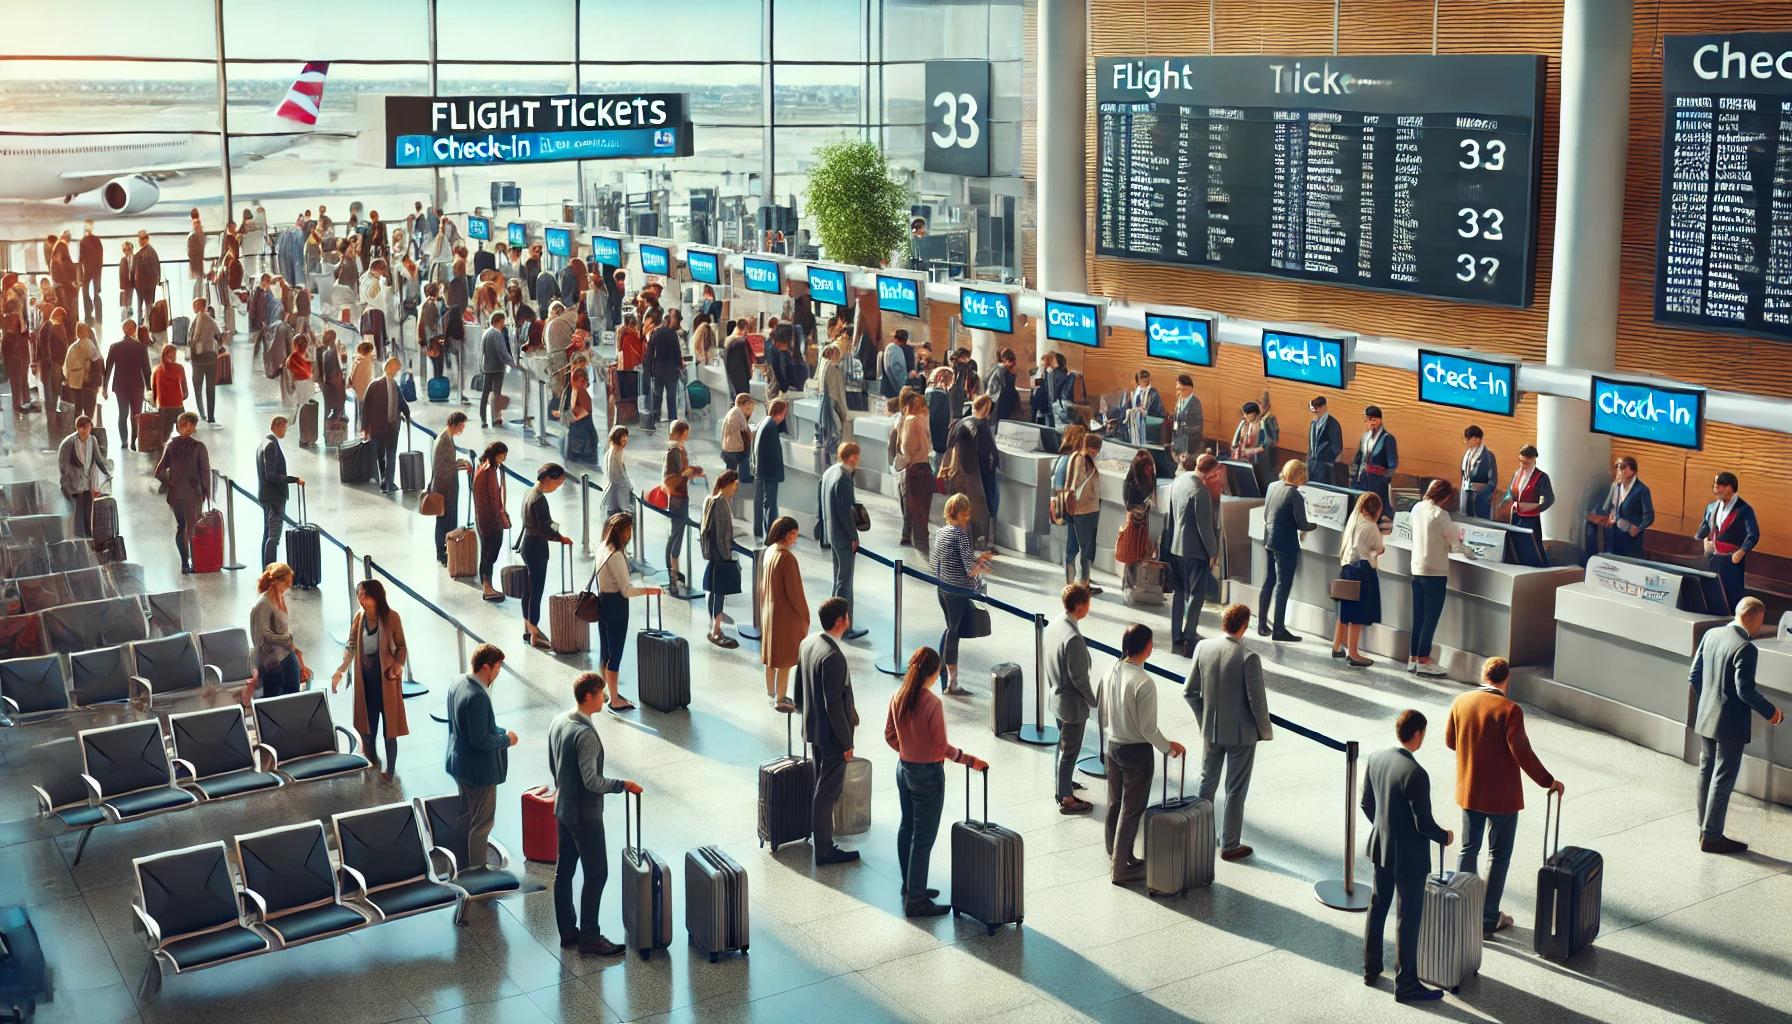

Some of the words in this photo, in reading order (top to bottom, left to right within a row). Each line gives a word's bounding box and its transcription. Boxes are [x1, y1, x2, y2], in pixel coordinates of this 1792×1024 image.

[1113, 60, 1194, 98] Flight
[432, 100, 541, 132] FLIGHT
[931, 91, 980, 149] 33
[1458, 138, 1507, 171] 33
